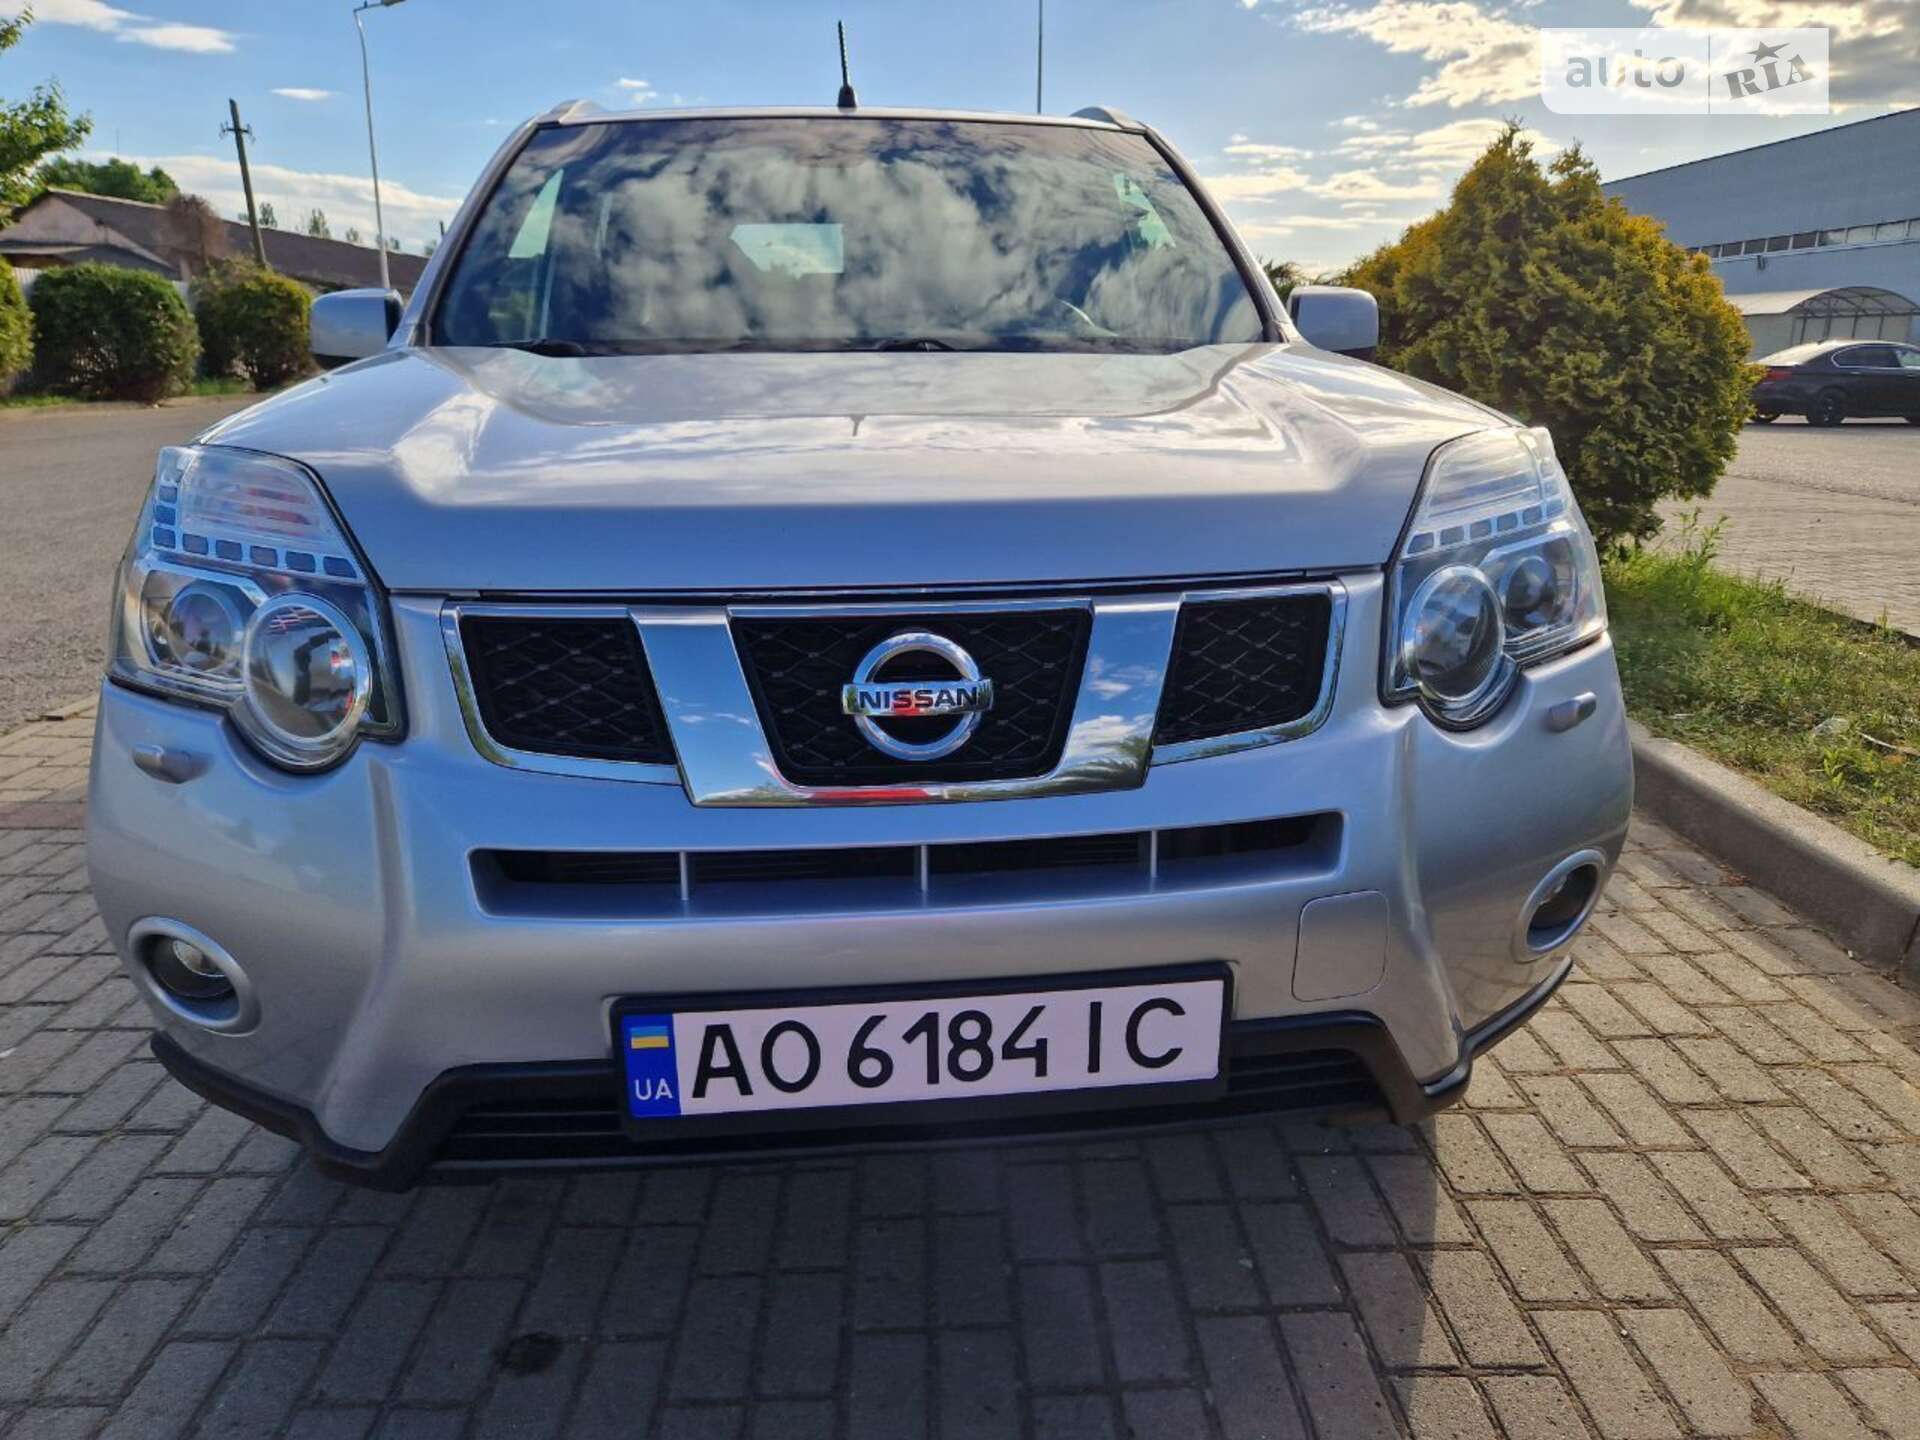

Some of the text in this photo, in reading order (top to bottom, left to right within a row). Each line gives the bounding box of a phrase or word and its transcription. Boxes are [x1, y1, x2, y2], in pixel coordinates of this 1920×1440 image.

[859, 687, 978, 710] NISSAN
[691, 997, 1187, 1099] AO 6184 IC
[634, 1077, 674, 1101] UA
